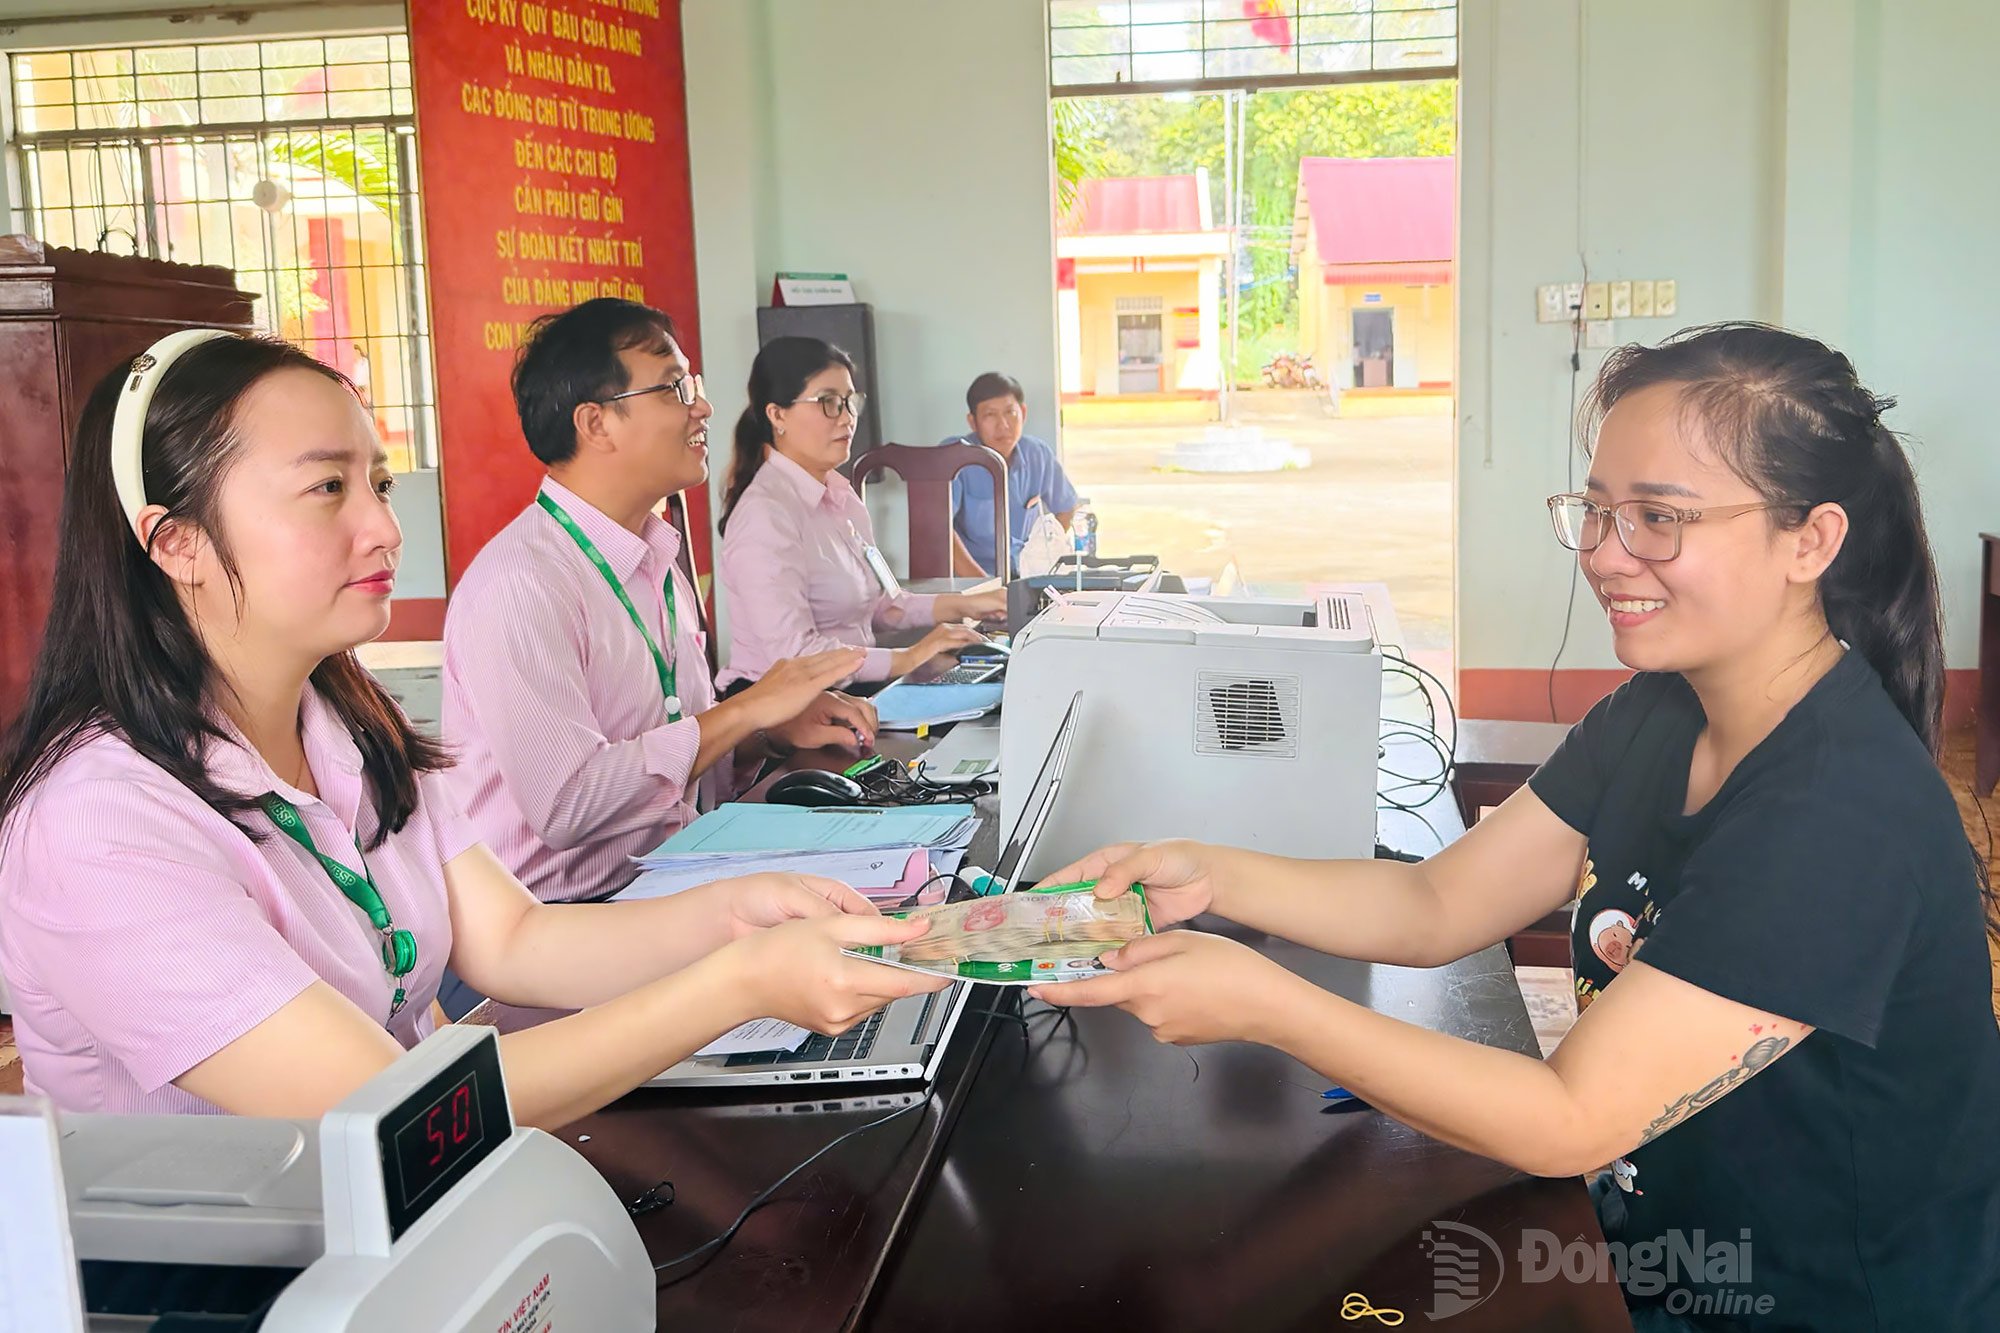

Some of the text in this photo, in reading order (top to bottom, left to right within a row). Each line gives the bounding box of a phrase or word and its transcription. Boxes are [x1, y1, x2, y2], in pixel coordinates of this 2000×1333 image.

[552, 5, 579, 42] BÁU
[581, 9, 607, 48] CỦA
[609, 17, 642, 57] ĐẢNG
[504, 38, 524, 75] VÀ
[527, 46, 564, 84] NHÂN
[567, 52, 594, 88] DÂN
[461, 78, 491, 115] CÁC
[535, 93, 558, 127] CHÍ
[560, 97, 579, 131] TỪ
[580, 106, 622, 138] TRUNG
[514, 131, 618, 186] ĐẾN CÁC CHI BỘ
[545, 180, 577, 220] PHẢI
[578, 188, 601, 222] GIỮ
[603, 189, 624, 224] GÌN
[496, 226, 643, 268] SỰ ĐOÀN KẾT NHẤT TRÍ
[502, 267, 531, 305] CỦA
[534, 269, 570, 306] ĐẢNG
[484, 321, 513, 351] CON
[427, 1085, 469, 1166] 50
[512, 1294, 532, 1322] VIỆT
[532, 1273, 550, 1299] NAM
